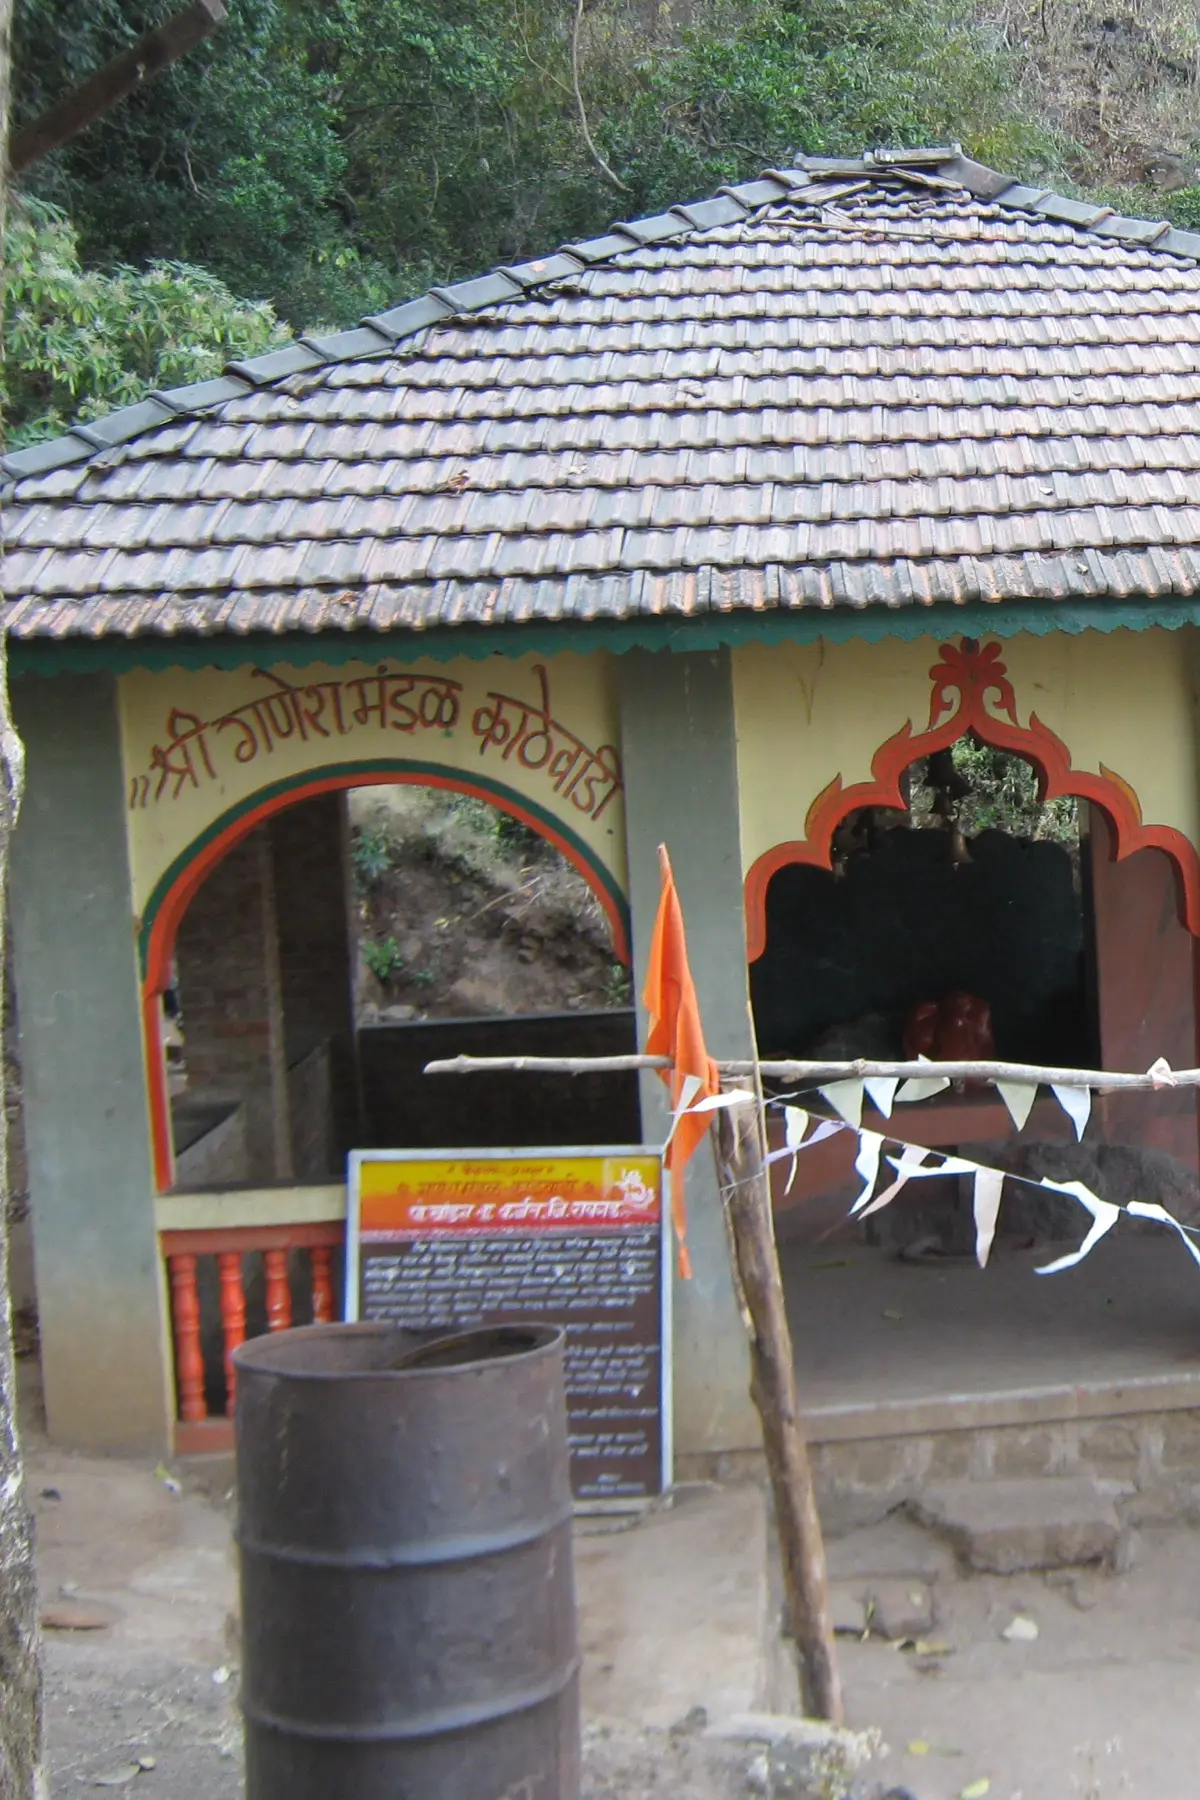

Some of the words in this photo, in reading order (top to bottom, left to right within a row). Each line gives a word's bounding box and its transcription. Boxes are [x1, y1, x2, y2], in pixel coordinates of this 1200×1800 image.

[211, 667, 343, 764] गणेश
[345, 665, 463, 733] मंडळ
[472, 664, 623, 821] काठेवाडी
